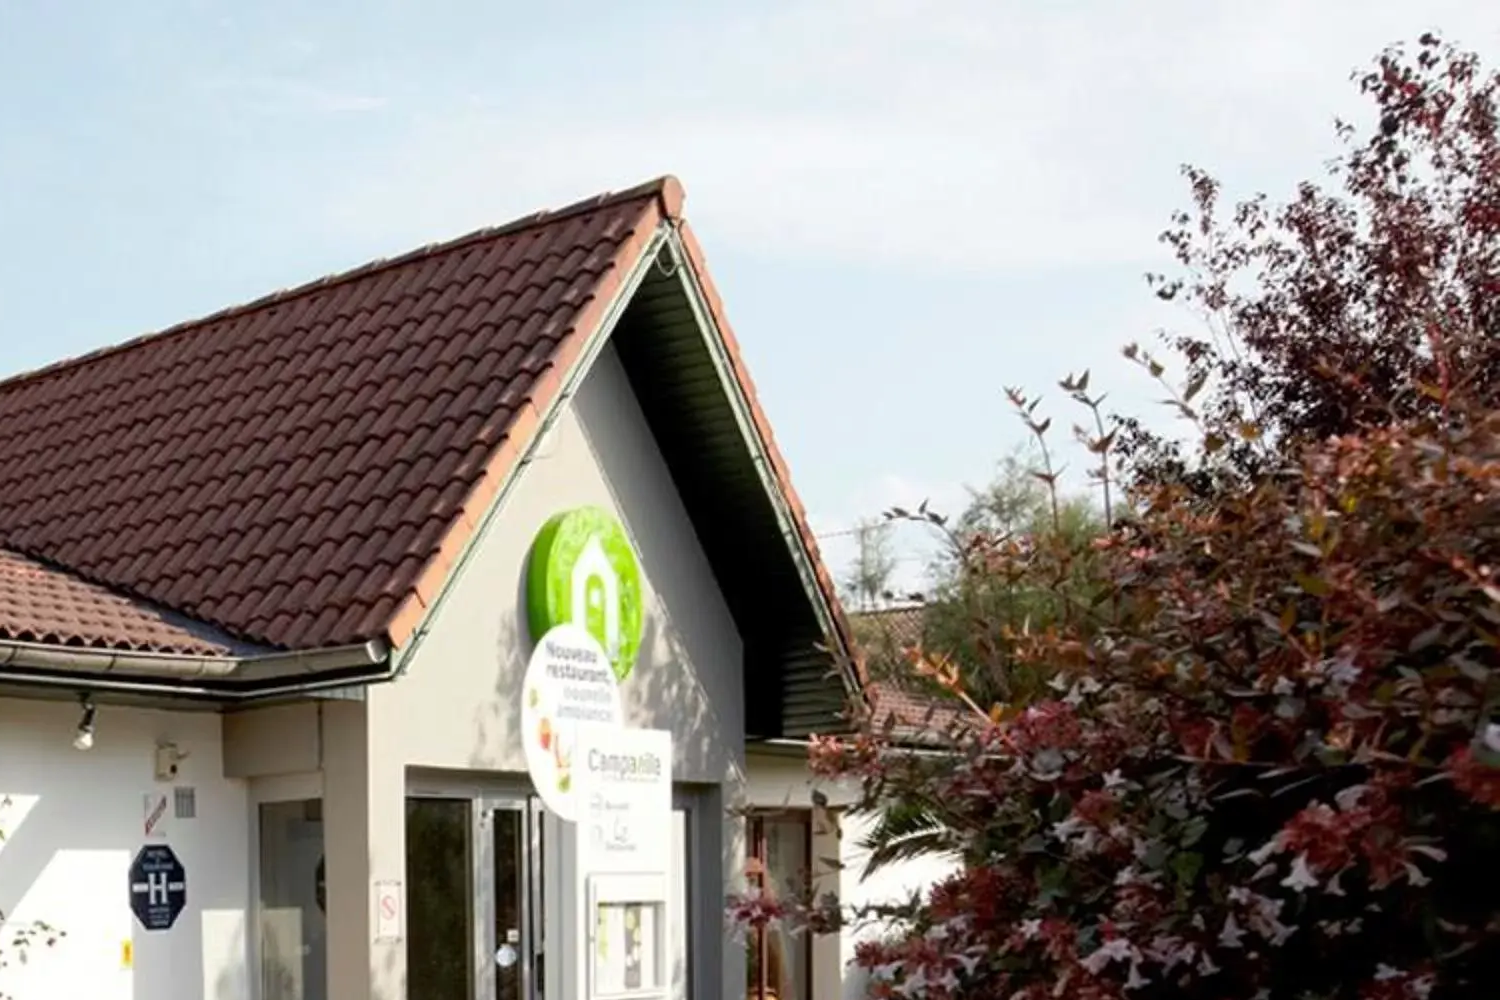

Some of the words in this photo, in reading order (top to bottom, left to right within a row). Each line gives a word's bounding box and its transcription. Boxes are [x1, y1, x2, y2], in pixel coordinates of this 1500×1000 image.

[546, 640, 598, 662] Nouveau
[588, 748, 661, 777] Campanile
[147, 872, 168, 904] H
